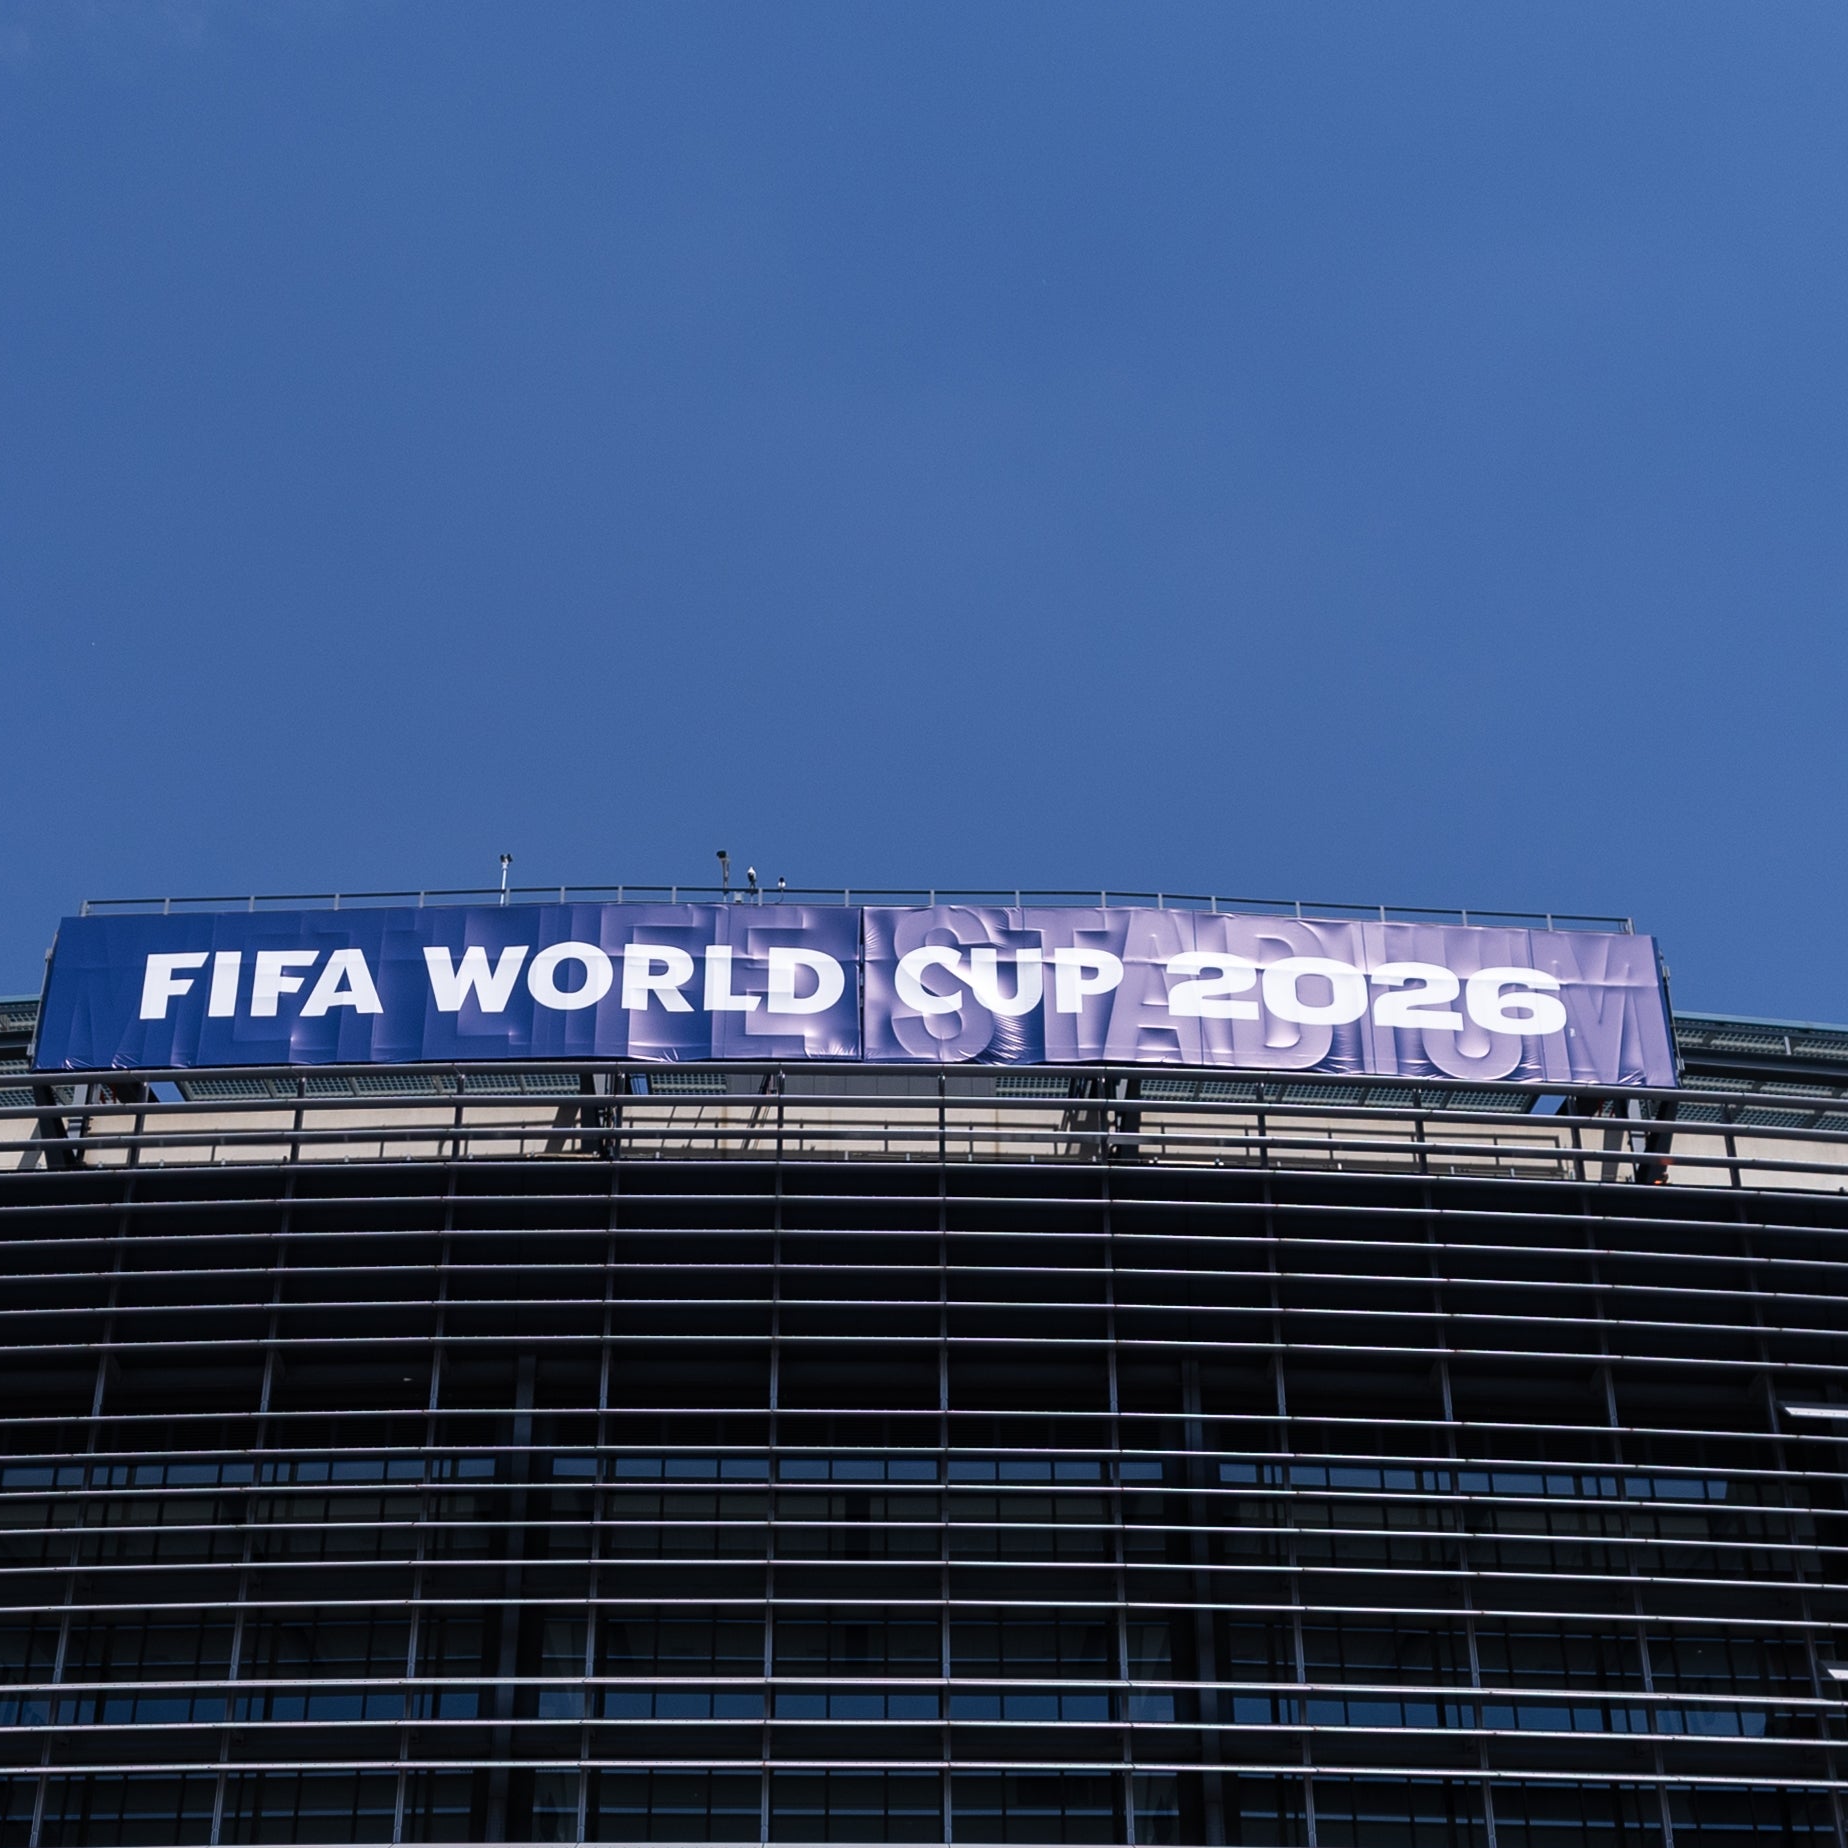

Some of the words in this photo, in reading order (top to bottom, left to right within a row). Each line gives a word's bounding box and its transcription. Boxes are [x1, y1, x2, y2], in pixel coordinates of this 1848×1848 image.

[139, 948, 384, 1020] FIFA
[422, 941, 845, 1015] WORLD
[894, 945, 1125, 1016] CUP
[1165, 951, 1567, 1036] 2026
